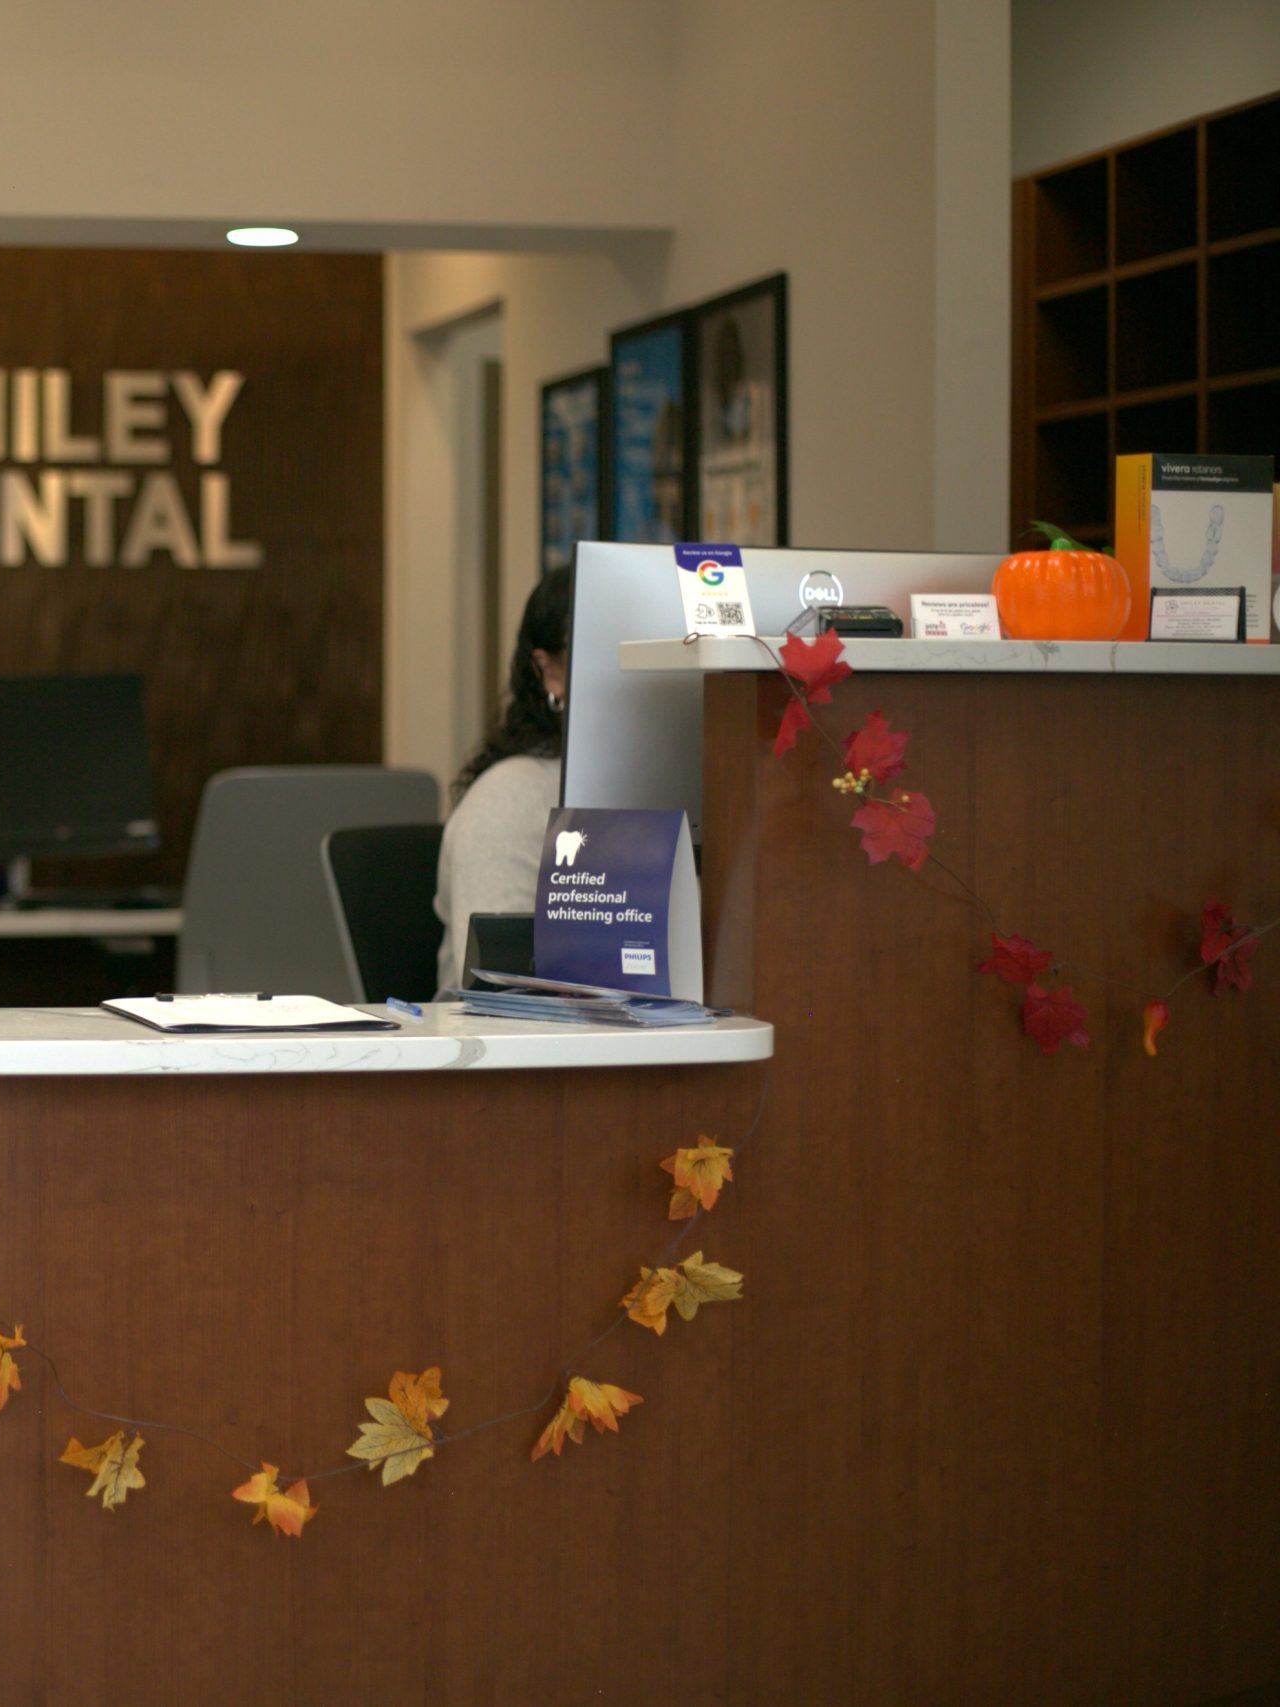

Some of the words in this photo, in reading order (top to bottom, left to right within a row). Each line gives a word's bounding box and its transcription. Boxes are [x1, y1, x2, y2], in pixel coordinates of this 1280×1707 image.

[1161, 463, 1190, 474] vivera
[805, 587, 839, 601] DELL
[550, 872, 606, 885] Certified
[548, 889, 627, 905] professional
[547, 906, 613, 925] whitening
[616, 908, 653, 923] office
